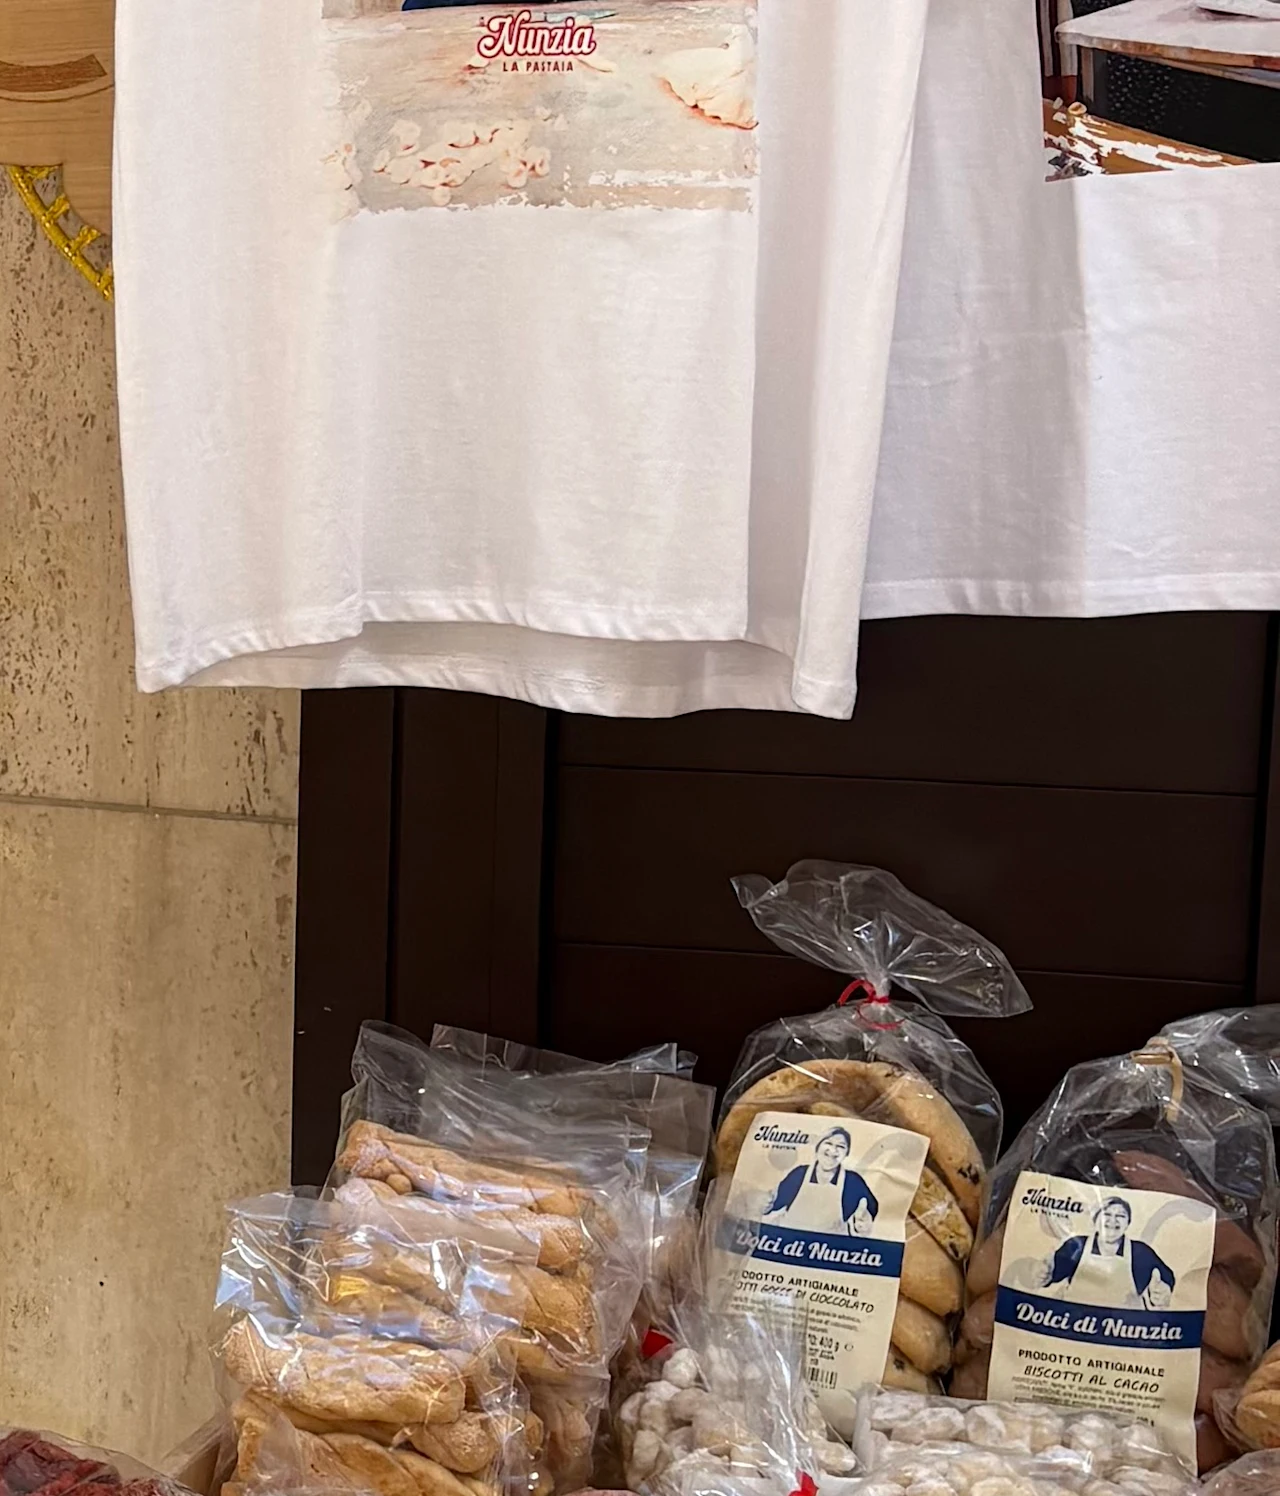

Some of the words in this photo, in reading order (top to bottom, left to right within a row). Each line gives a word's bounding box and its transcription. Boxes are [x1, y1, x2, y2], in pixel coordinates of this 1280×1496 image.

[477, 9, 597, 58] Nunzia
[502, 61, 519, 72] LA
[526, 61, 574, 72] PASTAIA
[754, 1125, 810, 1146] Nunzia
[1022, 1188, 1084, 1213] Nunzia
[736, 1228, 781, 1253] Dolci
[783, 1240, 804, 1258] di
[808, 1241, 884, 1268] Nunzia
[787, 1277, 860, 1298] ARTIGIANALE
[795, 1290, 807, 1300] DI
[809, 1292, 875, 1314] CIOCCOLATO
[1016, 1302, 1071, 1330] Dolci
[1073, 1316, 1097, 1335] di
[1101, 1317, 1184, 1341] Nunzia
[1018, 1348, 1081, 1367] PRODOTTO
[1087, 1358, 1165, 1378] ARTIGIANALE
[1024, 1365, 1084, 1383] BISCOTTI
[1089, 1373, 1107, 1386] AL
[1113, 1378, 1160, 1394] CACAO
